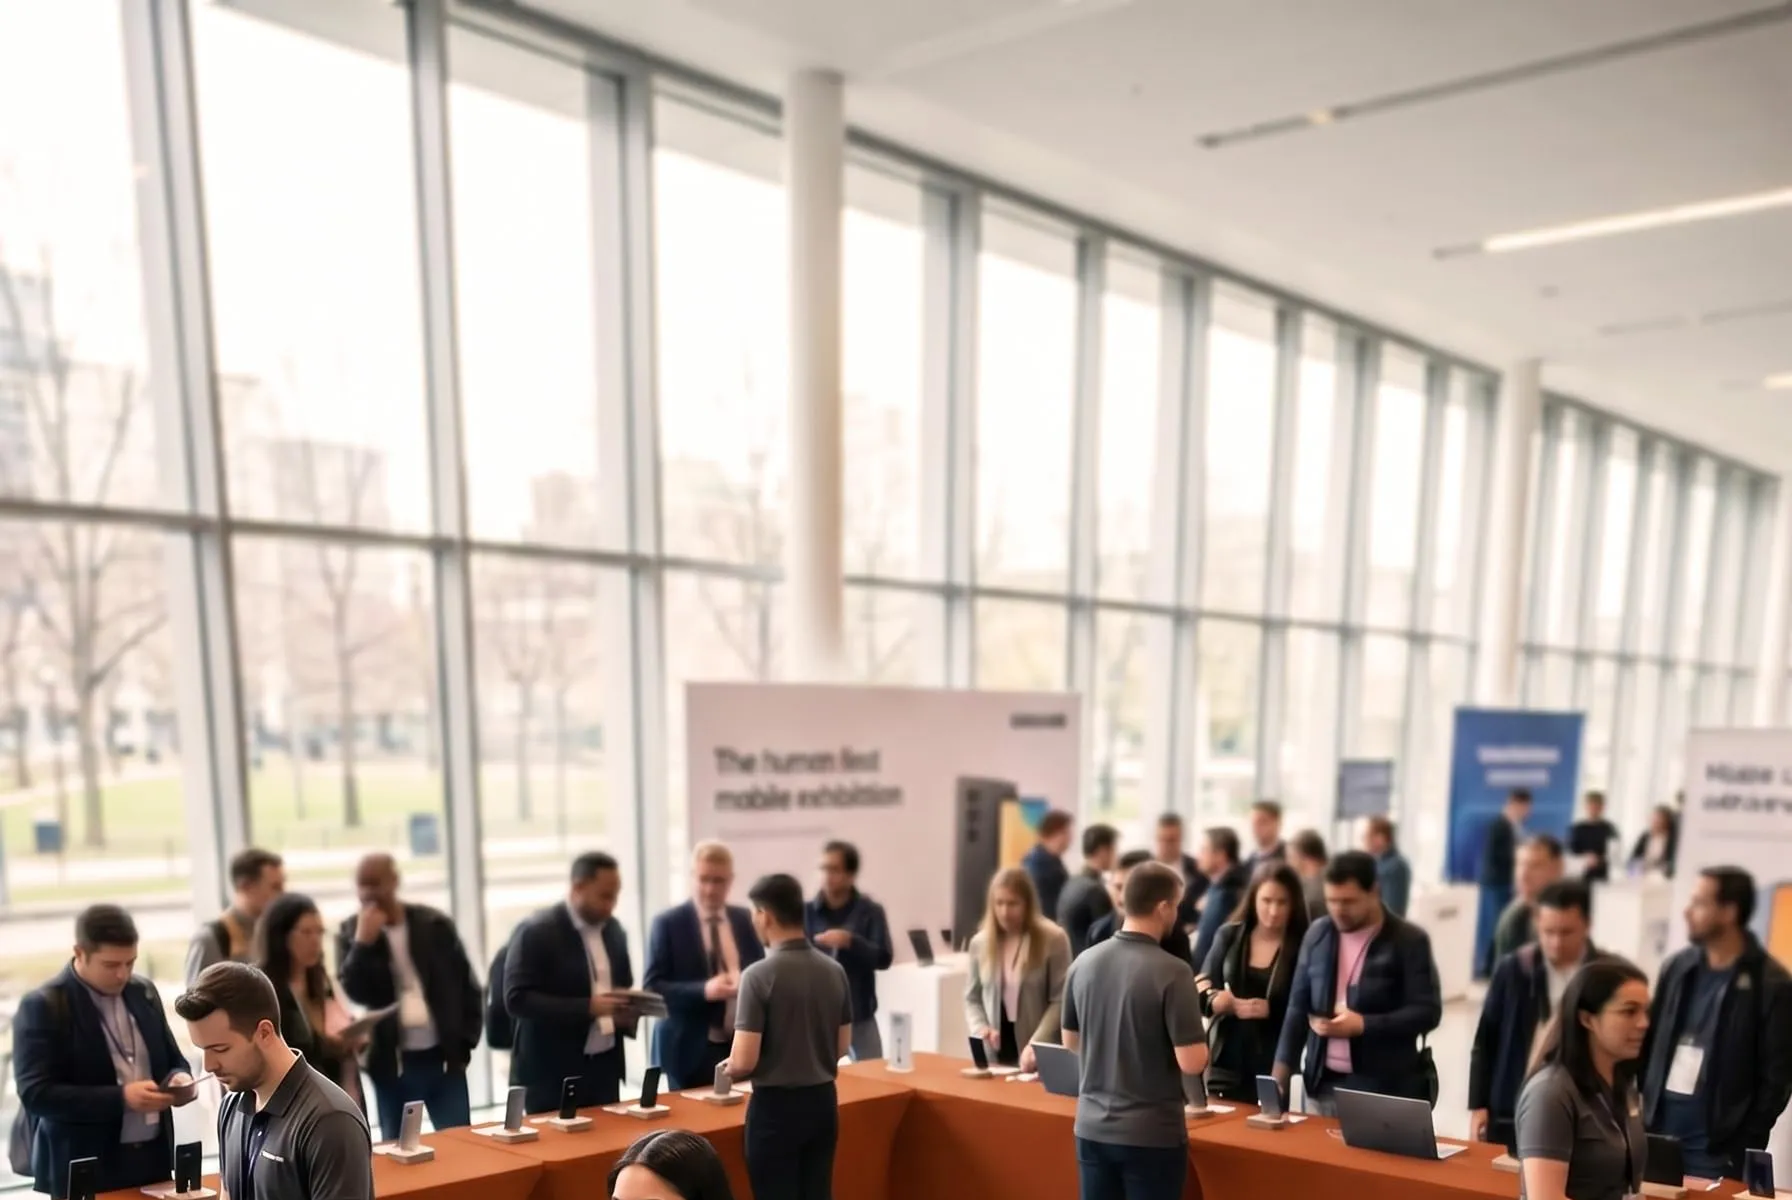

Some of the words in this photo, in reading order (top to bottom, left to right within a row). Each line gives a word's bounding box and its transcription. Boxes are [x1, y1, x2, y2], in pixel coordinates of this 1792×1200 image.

[714, 746, 756, 774] The
[763, 749, 834, 774] human
[715, 785, 791, 811] mobile
